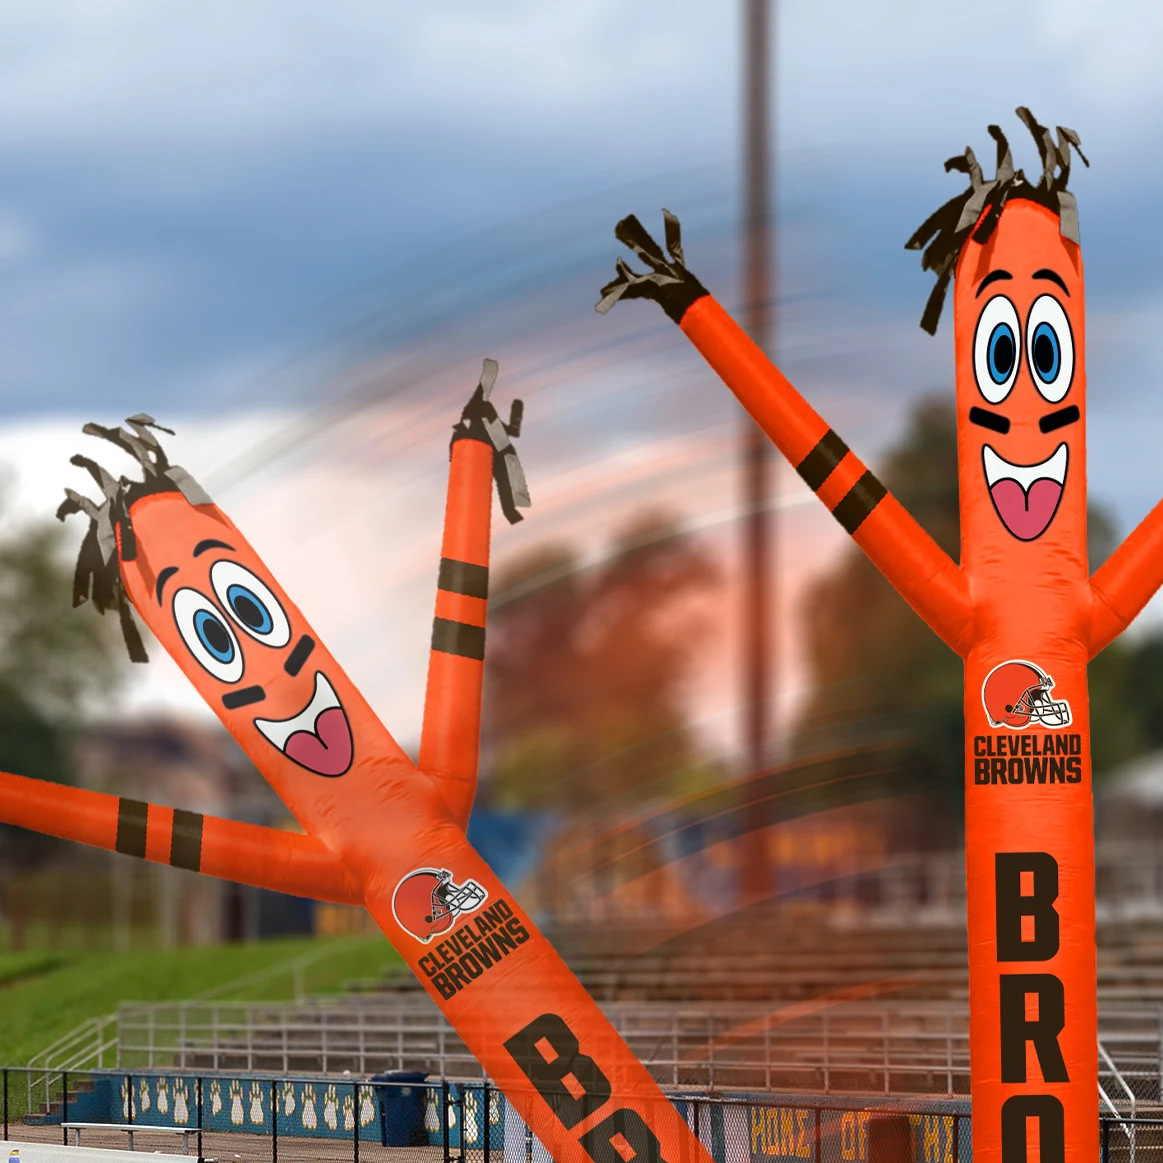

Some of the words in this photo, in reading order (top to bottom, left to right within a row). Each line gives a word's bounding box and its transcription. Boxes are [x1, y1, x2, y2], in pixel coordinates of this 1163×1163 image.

[974, 734, 1081, 757] CLEVELAND
[974, 757, 1082, 785] BROWNS
[417, 899, 514, 978] CLEVELAND
[430, 917, 531, 1001] BROWNS
[751, 1108, 811, 1159] HOME
